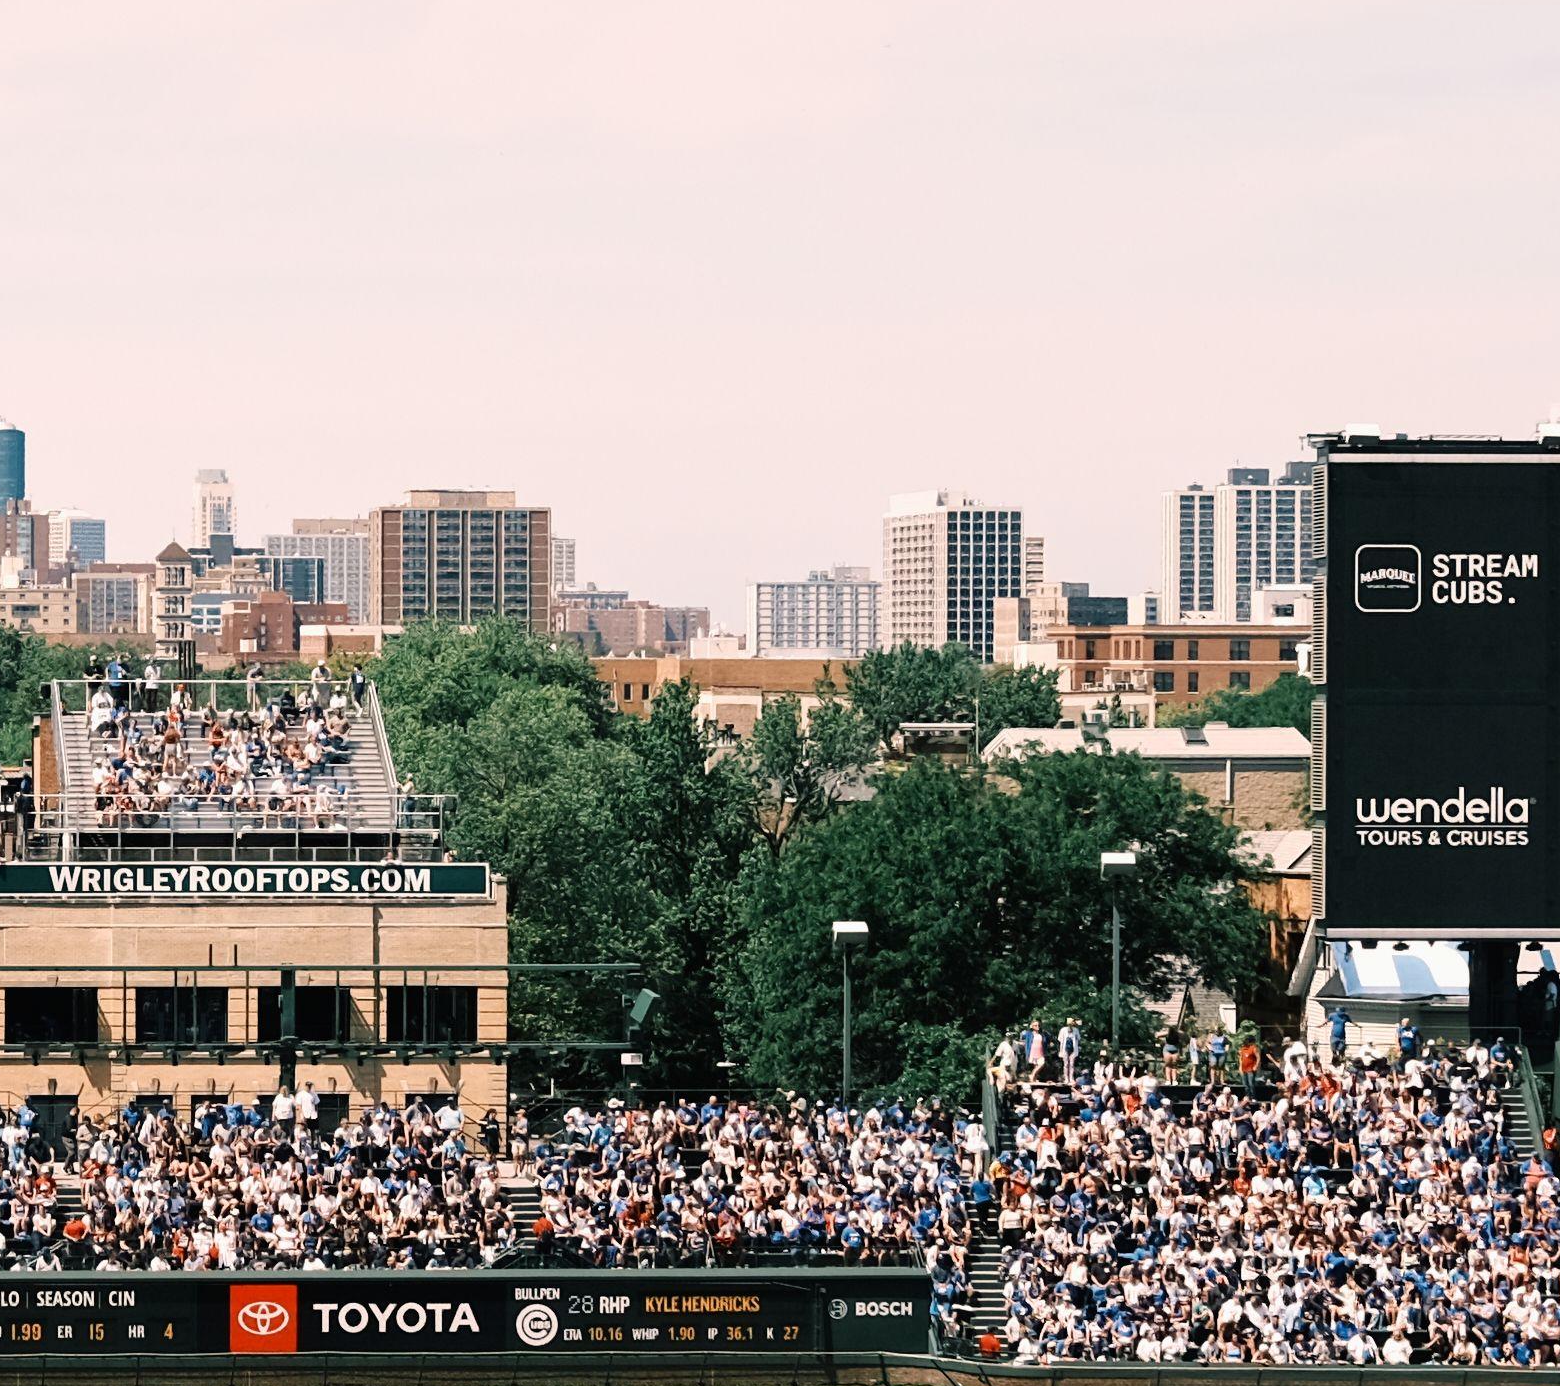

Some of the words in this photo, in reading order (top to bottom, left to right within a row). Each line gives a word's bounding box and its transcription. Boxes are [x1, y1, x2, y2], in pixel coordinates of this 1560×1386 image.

[1432, 554, 1539, 577] STREAM
[1359, 566, 1415, 584] MARQUEE
[1432, 581, 1516, 604] CUBS.
[1356, 786, 1529, 823] wendella
[1356, 830, 1423, 846] TOURS
[1428, 831, 1441, 846] &
[1446, 830, 1529, 846] CRUISES
[36, 1290, 95, 1307] SEASON
[108, 1290, 135, 1307] CIN
[514, 1287, 560, 1301] BULLPEN
[567, 1295, 594, 1313] 28
[599, 1295, 631, 1313] RHP
[645, 1296, 680, 1312] KYLE
[681, 1295, 760, 1312] HENDRICKS
[855, 1301, 913, 1316] BOSCH
[313, 1302, 480, 1334] TOYOTA
[57, 1324, 73, 1339] ER
[88, 1324, 104, 1341] 15
[128, 1324, 145, 1339] HR
[163, 1323, 174, 1340] 4
[588, 1328, 623, 1341] 10.16
[632, 1328, 659, 1341] WHIP
[668, 1327, 696, 1341] 1.90
[707, 1327, 719, 1341] IP
[726, 1327, 754, 1341] 36.1
[766, 1327, 775, 1340] K
[783, 1326, 799, 1340] 27
